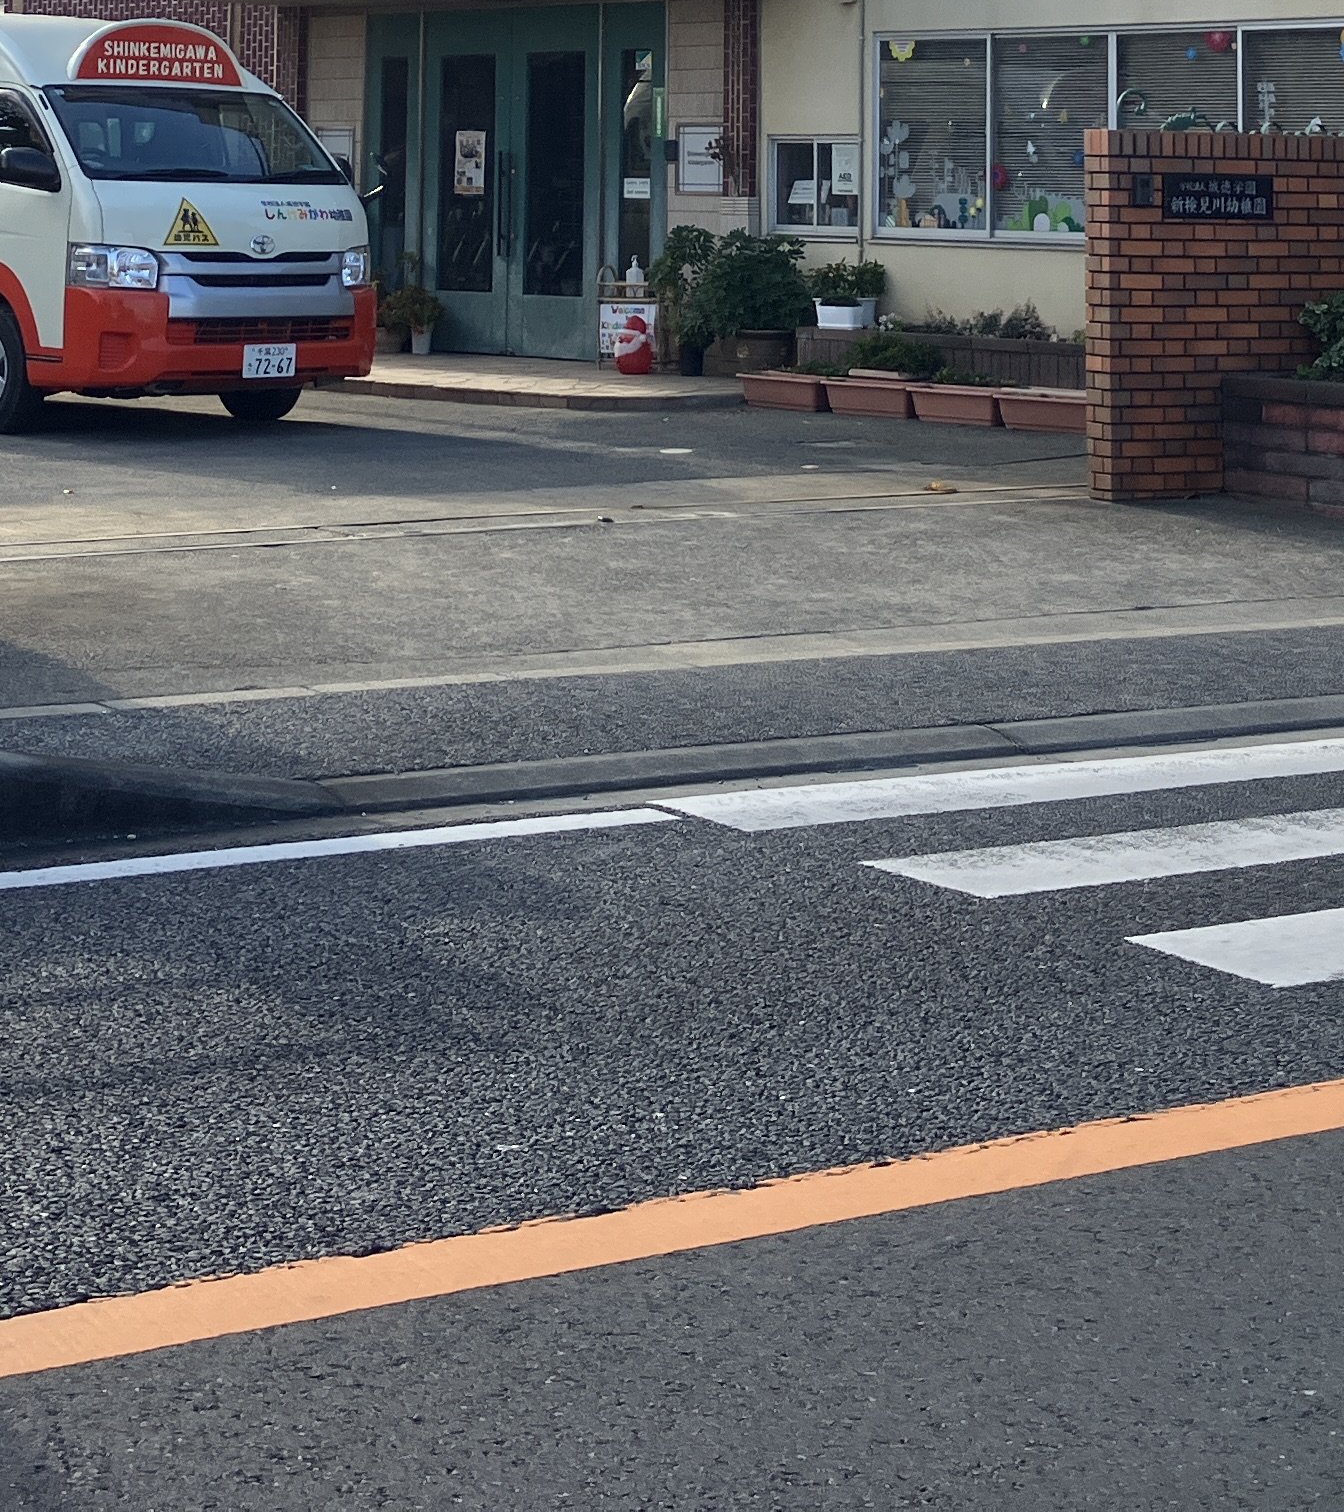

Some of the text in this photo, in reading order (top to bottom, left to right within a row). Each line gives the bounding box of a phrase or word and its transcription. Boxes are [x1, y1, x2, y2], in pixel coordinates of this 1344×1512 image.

[103, 40, 217, 61] SHINKEMIGAWA
[97, 57, 224, 79] KINDERGARTEN
[1171, 195, 1267, 215] 新検見川幼稚園
[255, 357, 293, 375] 72-67
